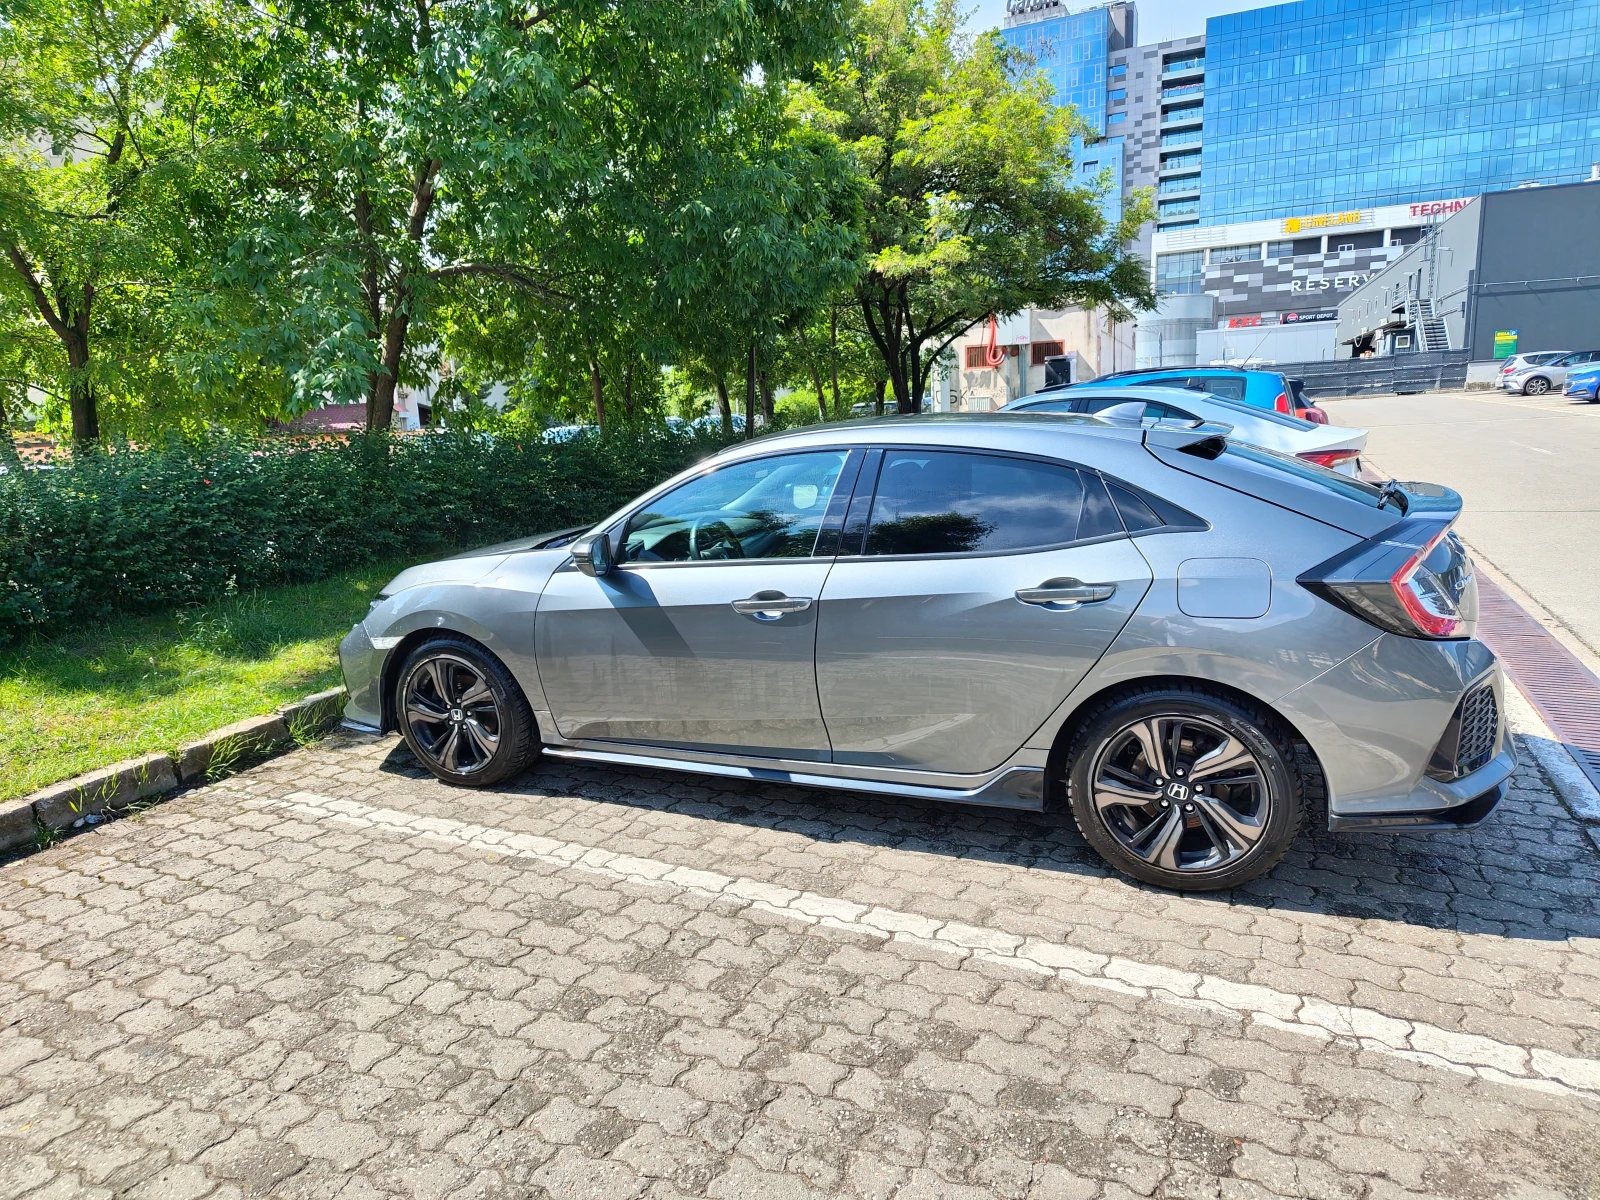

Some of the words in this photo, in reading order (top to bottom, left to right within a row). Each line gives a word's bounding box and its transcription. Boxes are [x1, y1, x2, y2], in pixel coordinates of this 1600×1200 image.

[1410, 198, 1476, 216] TECHN
[1304, 211, 1361, 228] CINELAND
[1228, 316, 1262, 328] KFC
